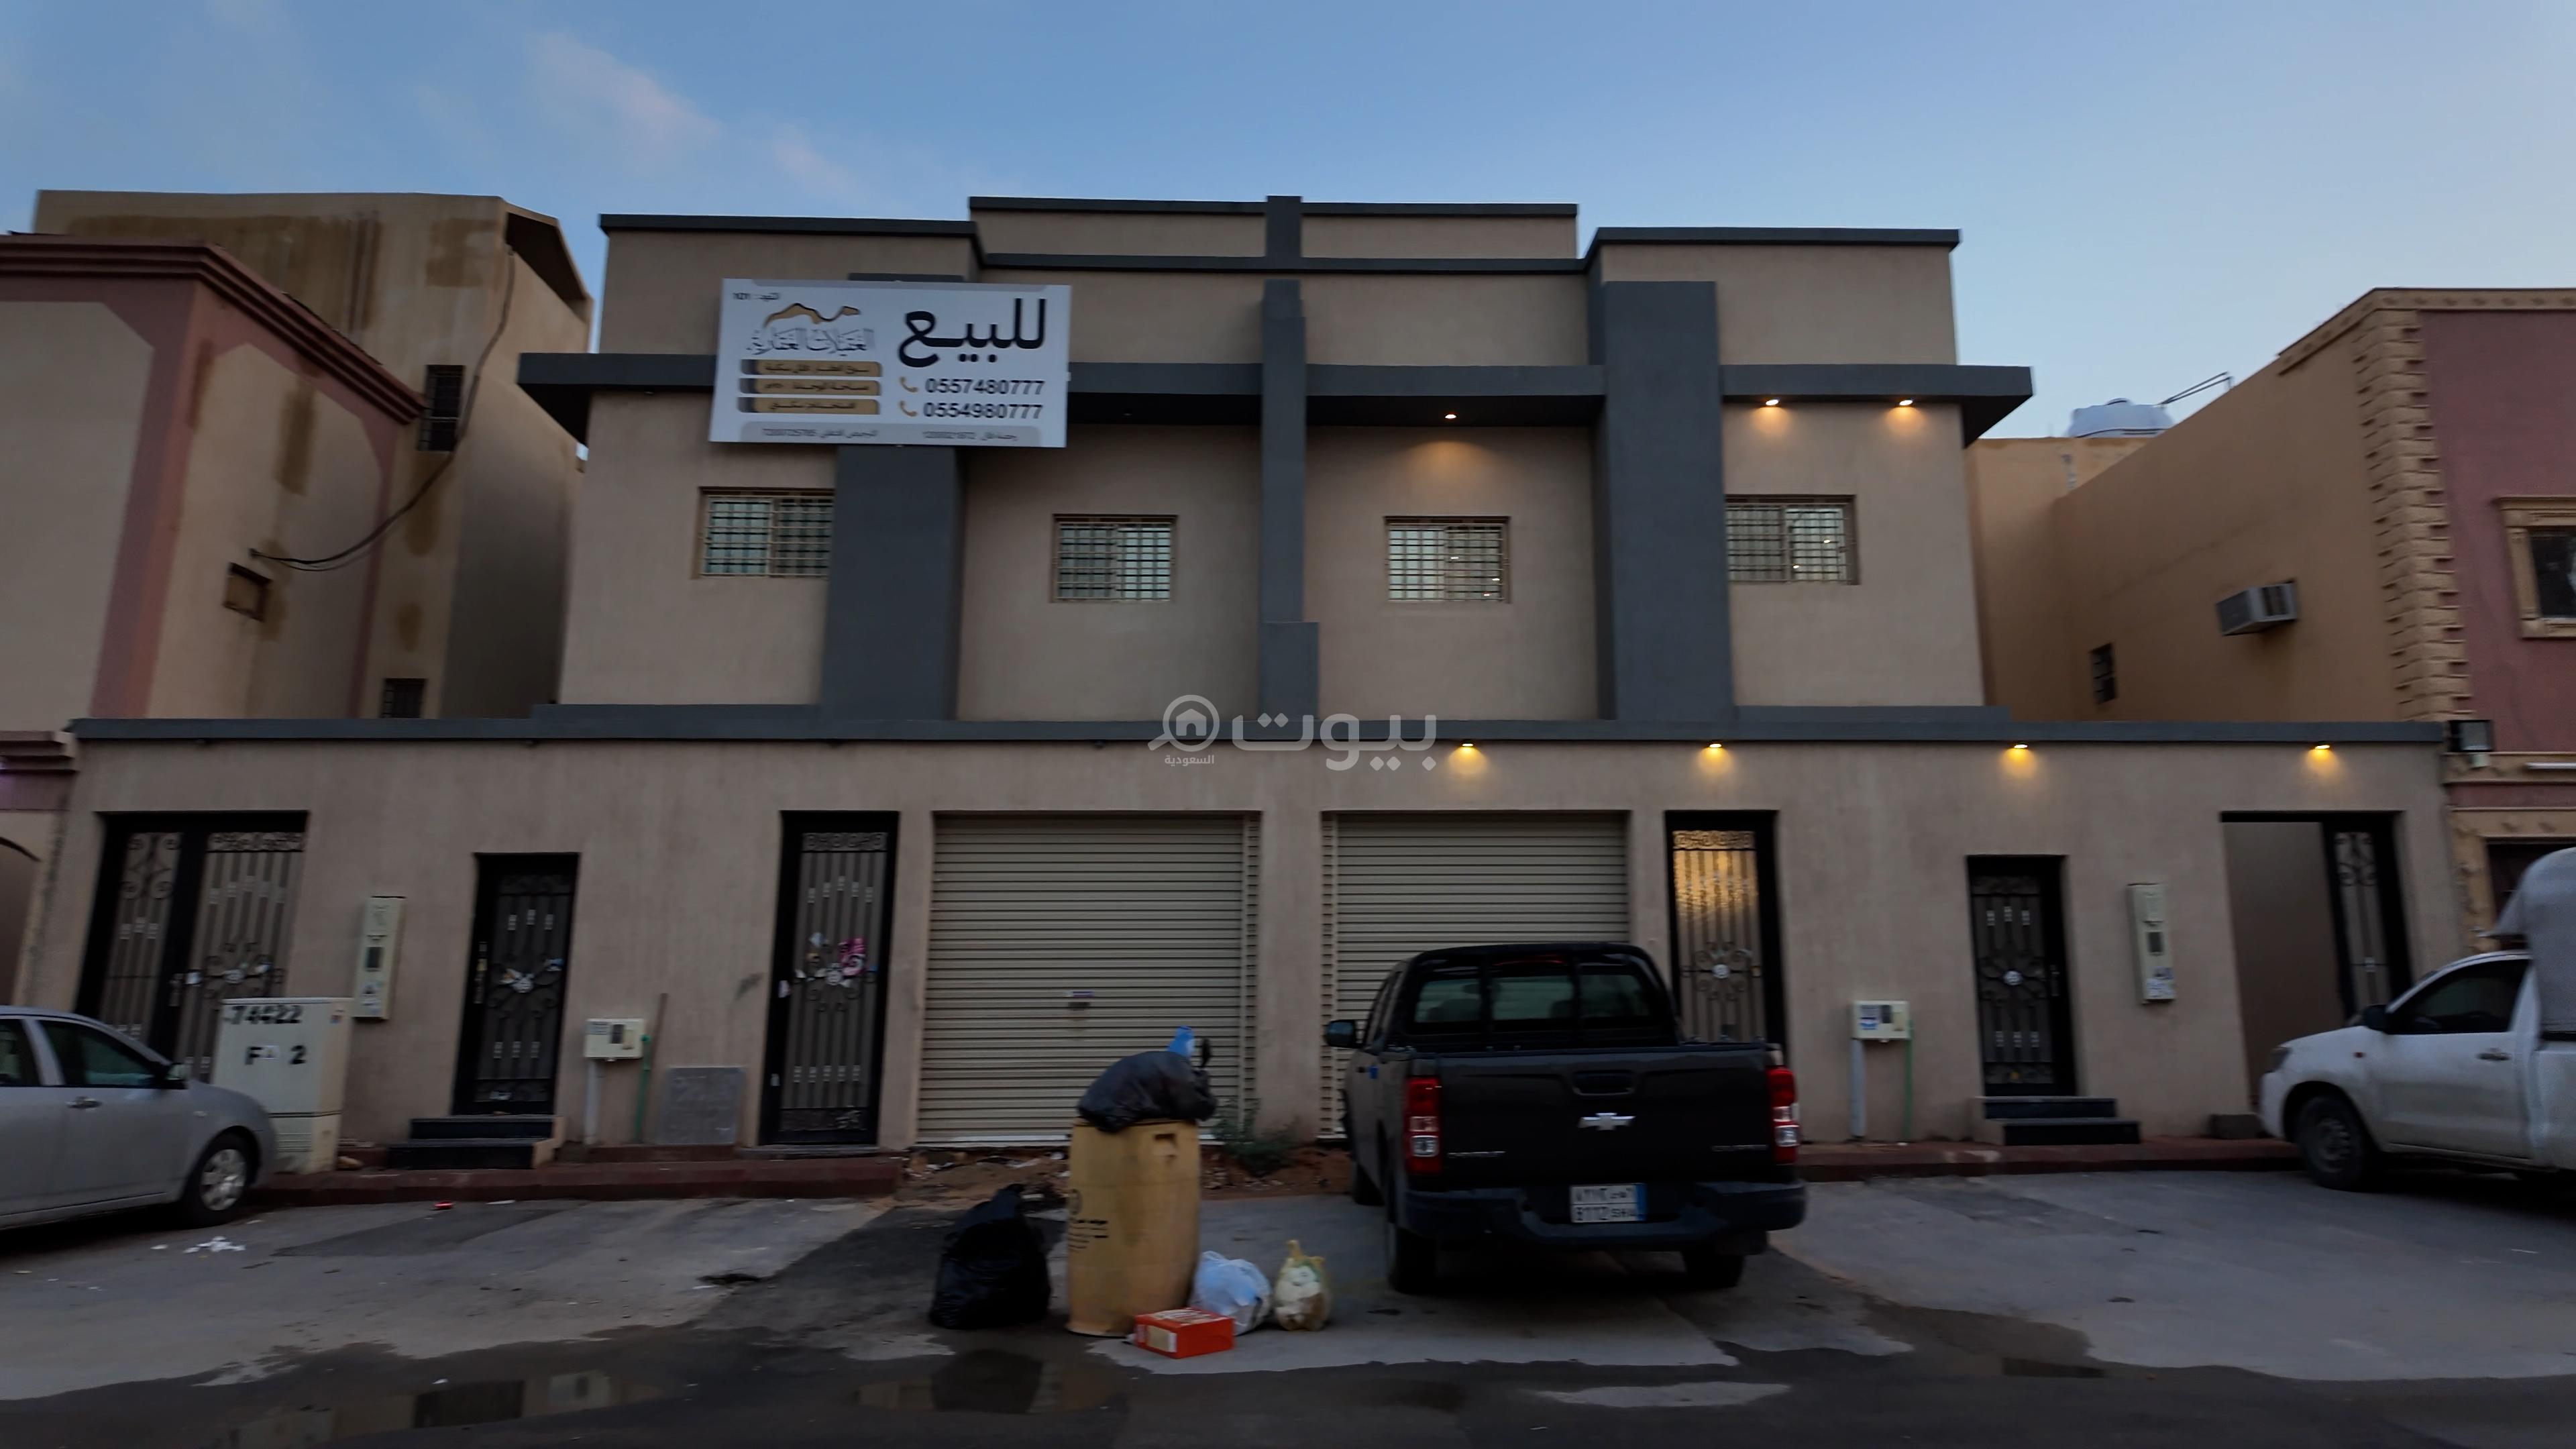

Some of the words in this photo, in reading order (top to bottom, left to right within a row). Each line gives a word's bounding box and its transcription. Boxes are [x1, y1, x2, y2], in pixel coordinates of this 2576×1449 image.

[898, 298, 1047, 368] للبيع
[925, 378, 1046, 394] 0557480777
[923, 402, 1044, 419] 0554980777
